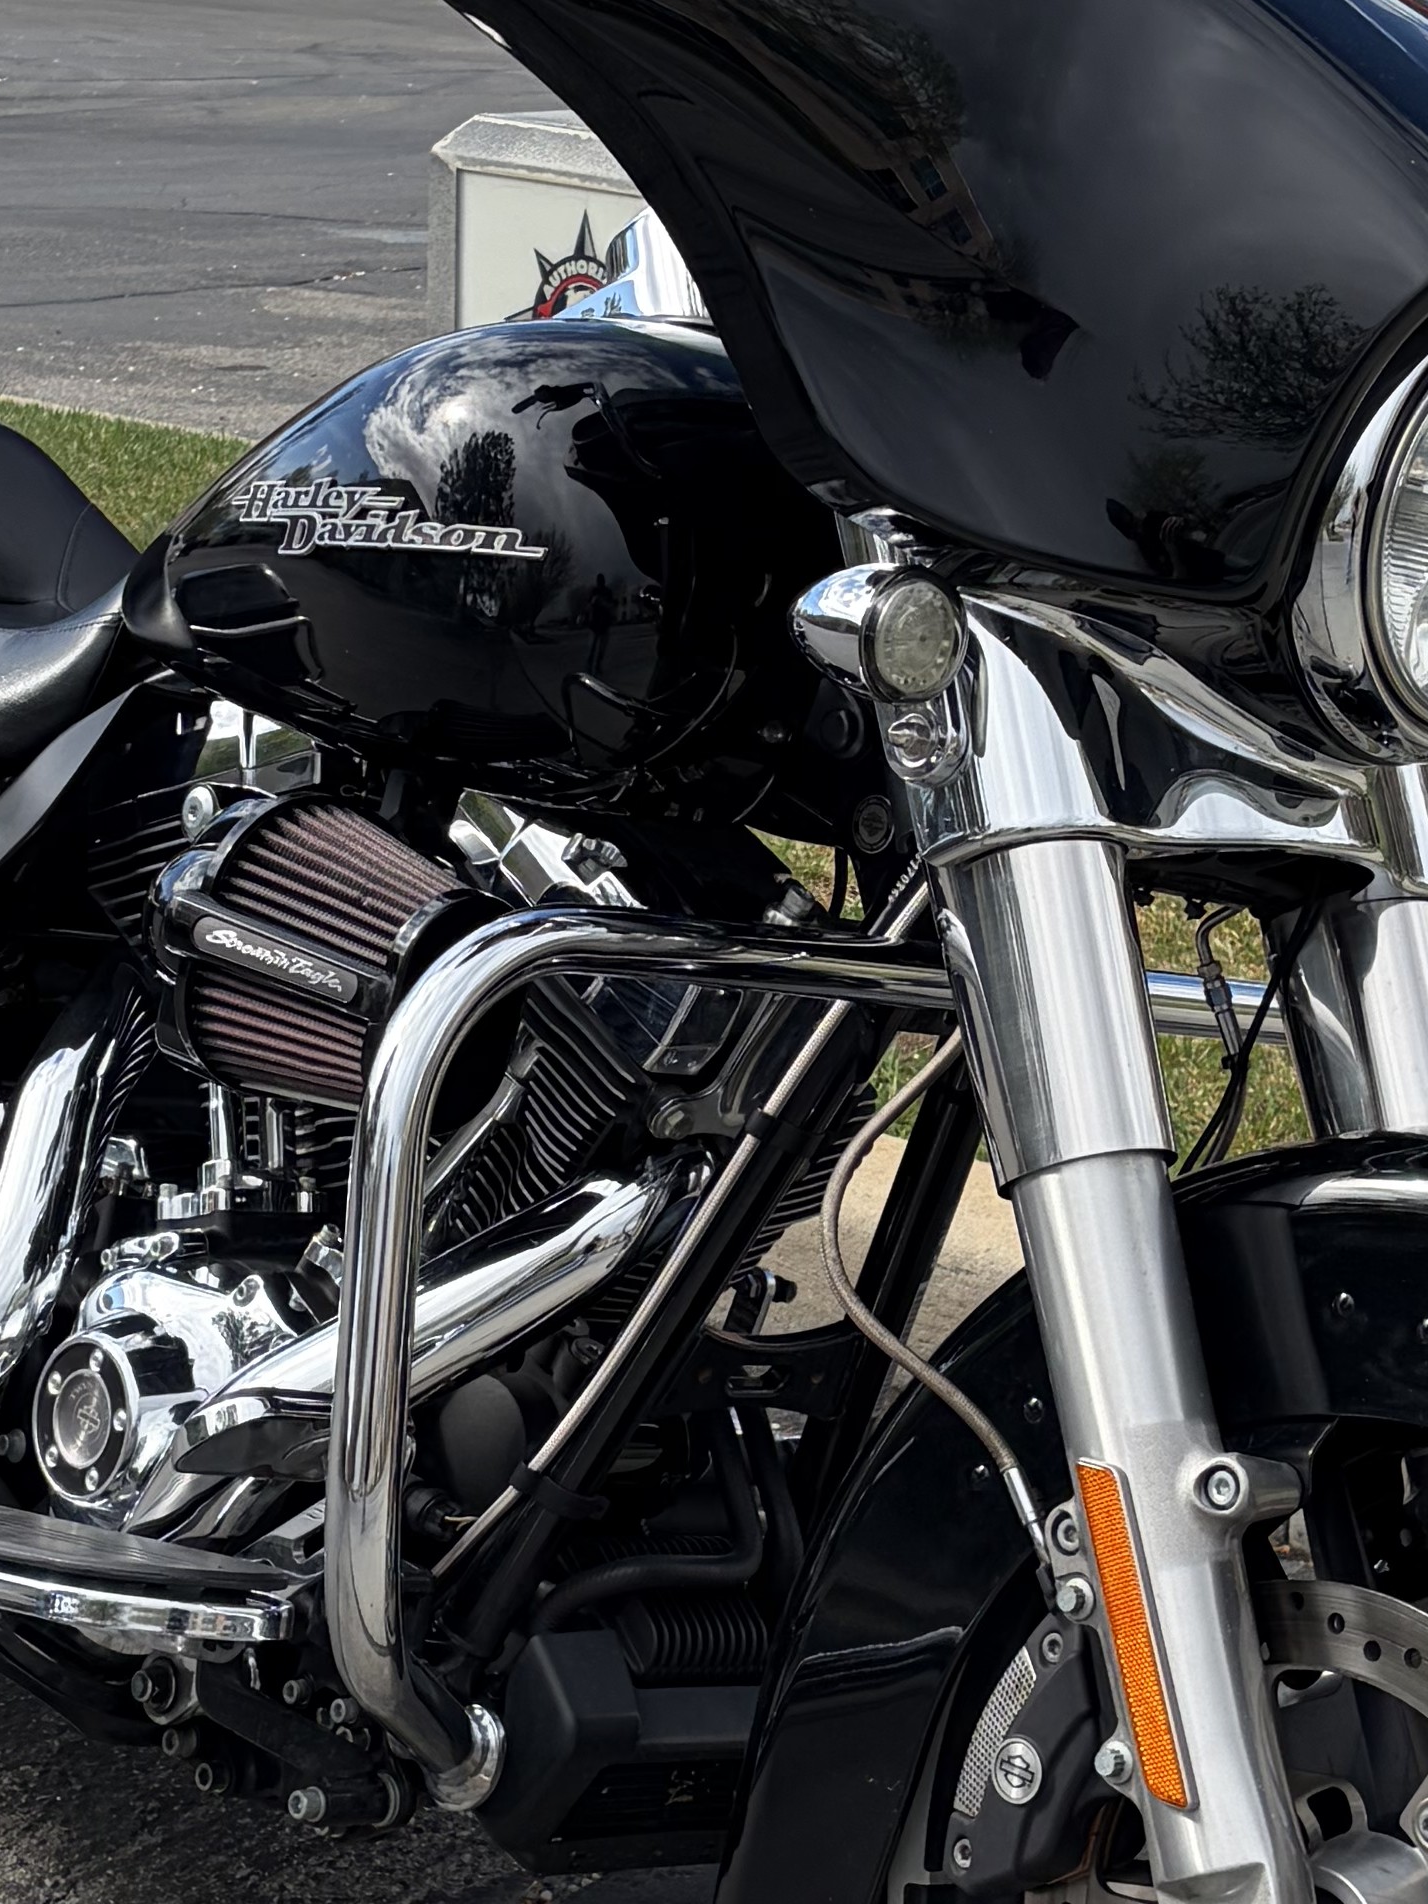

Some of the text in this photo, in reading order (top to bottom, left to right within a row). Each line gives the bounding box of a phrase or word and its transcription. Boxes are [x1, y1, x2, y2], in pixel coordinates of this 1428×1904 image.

[232, 477, 405, 522] Harley
[278, 509, 549, 561] Davidson
[288, 956, 342, 992] Eagle
